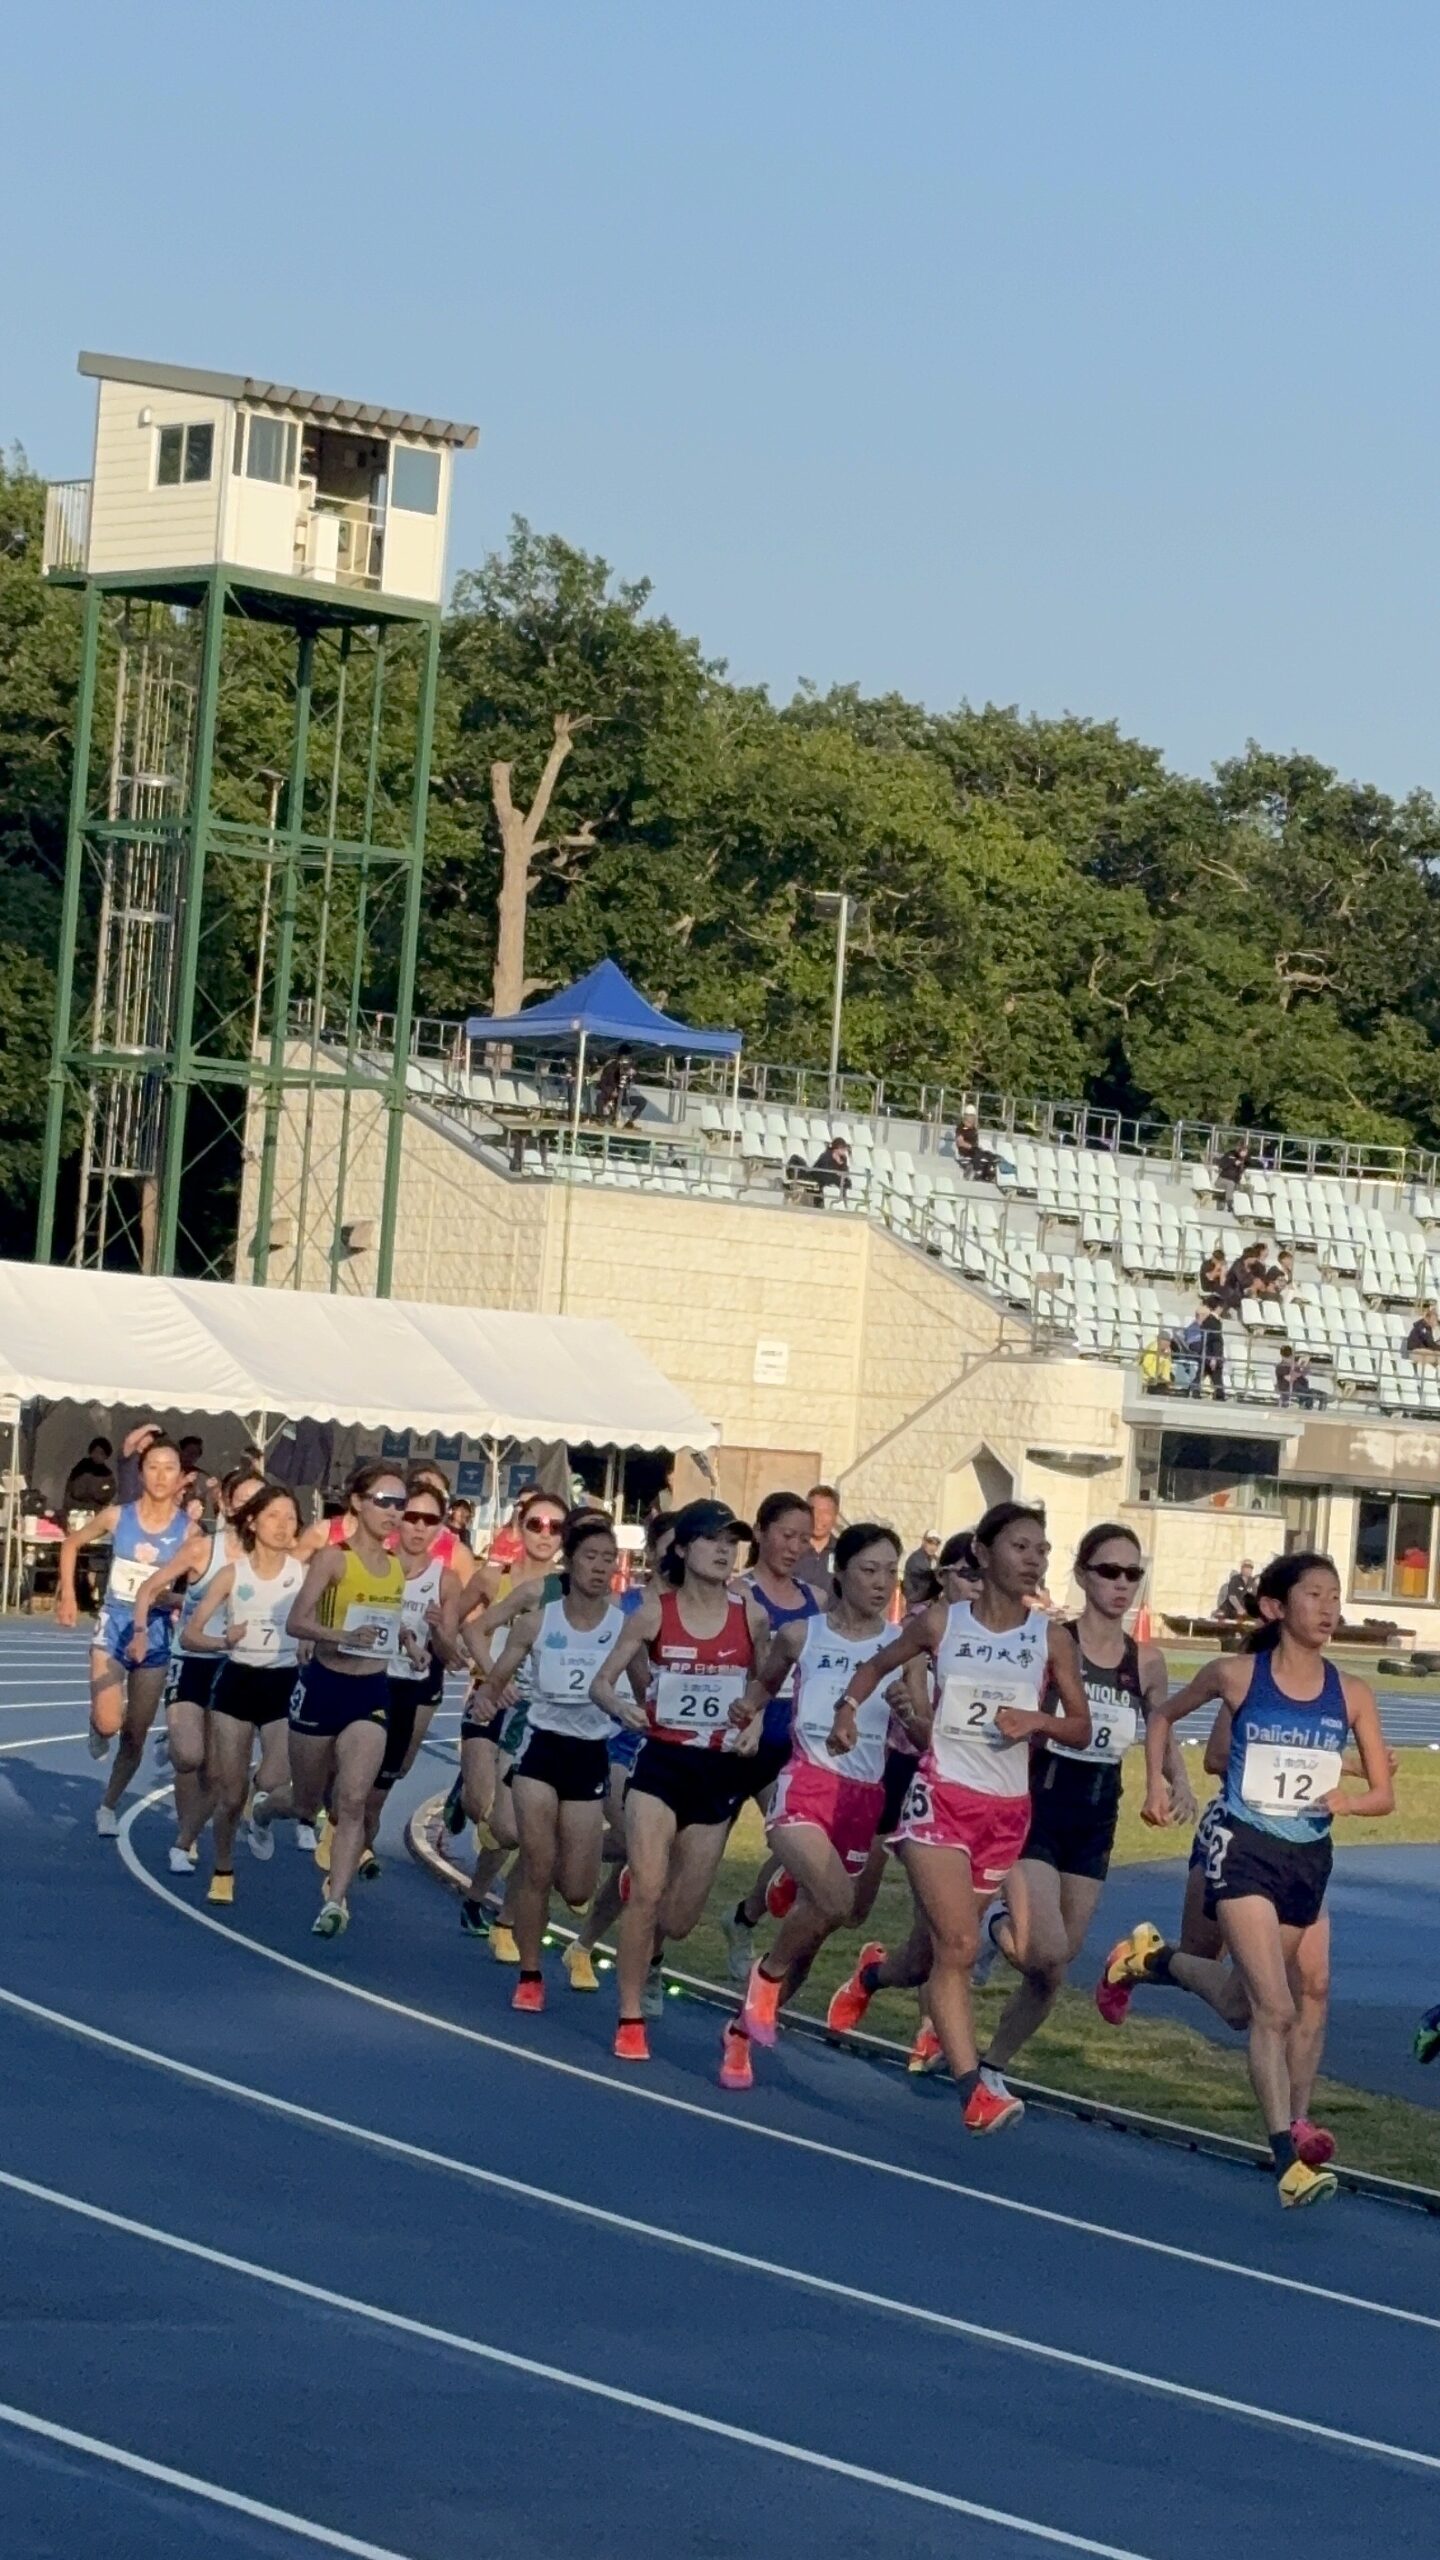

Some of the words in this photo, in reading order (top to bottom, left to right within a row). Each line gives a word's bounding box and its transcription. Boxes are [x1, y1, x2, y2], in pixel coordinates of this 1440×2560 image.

[261, 1628, 275, 1646] 7
[569, 1669, 585, 1690] 2
[1084, 1681, 1130, 1708] NIQLO
[680, 1695, 720, 1718] 26
[1094, 1727, 1112, 1748] 8
[1273, 1771, 1313, 1801] 12
